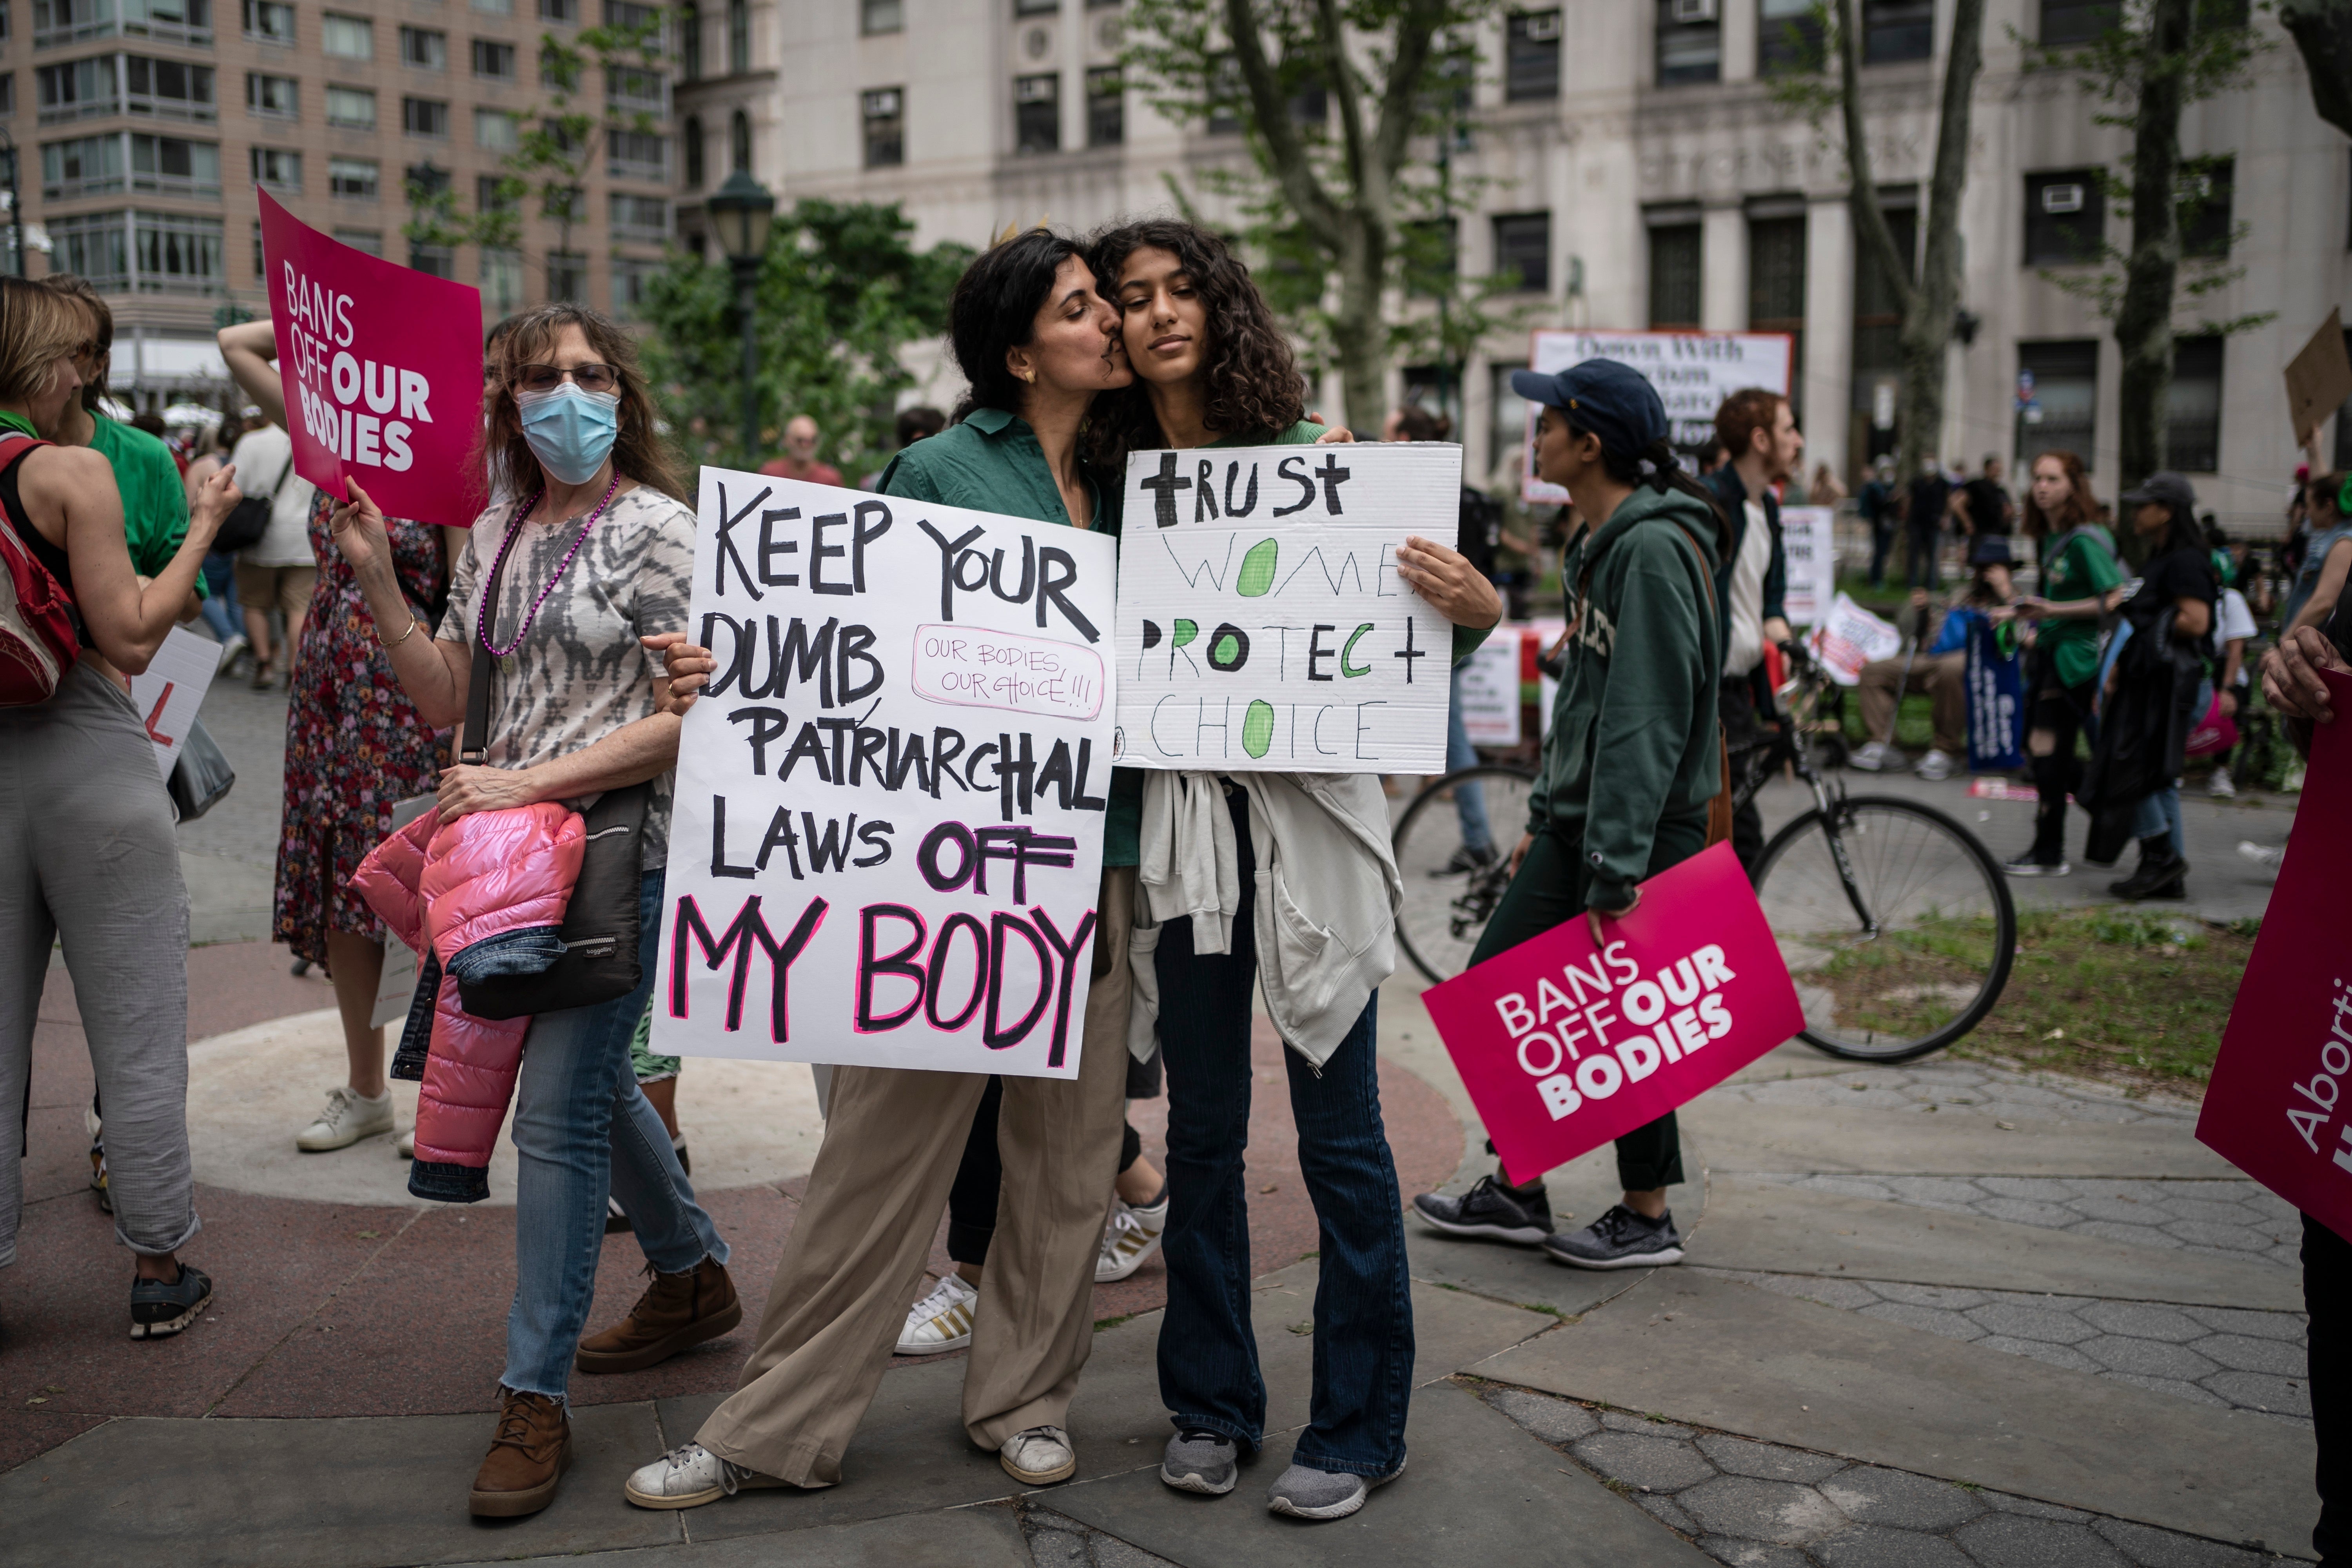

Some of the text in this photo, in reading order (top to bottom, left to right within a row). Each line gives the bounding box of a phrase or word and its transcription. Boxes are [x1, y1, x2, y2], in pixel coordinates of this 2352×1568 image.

[284, 260, 354, 348] BANS
[291, 322, 433, 423] OFF OUR
[298, 379, 414, 472] BODIES
[715, 481, 1100, 643] KEEP YOUR
[1162, 532, 1411, 598] WOME
[926, 638, 967, 662] OUR
[942, 672, 990, 699] OUR
[726, 706, 1106, 822] PATRIARCHAL
[1151, 695, 1387, 760] CHOICE
[710, 794, 1078, 906] LAWS OFF
[668, 894, 1097, 1069] MY BODY
[1495, 940, 1639, 1039] BANS
[1517, 944, 1736, 1076] OFF OUR
[1536, 993, 1732, 1122] BODIES
